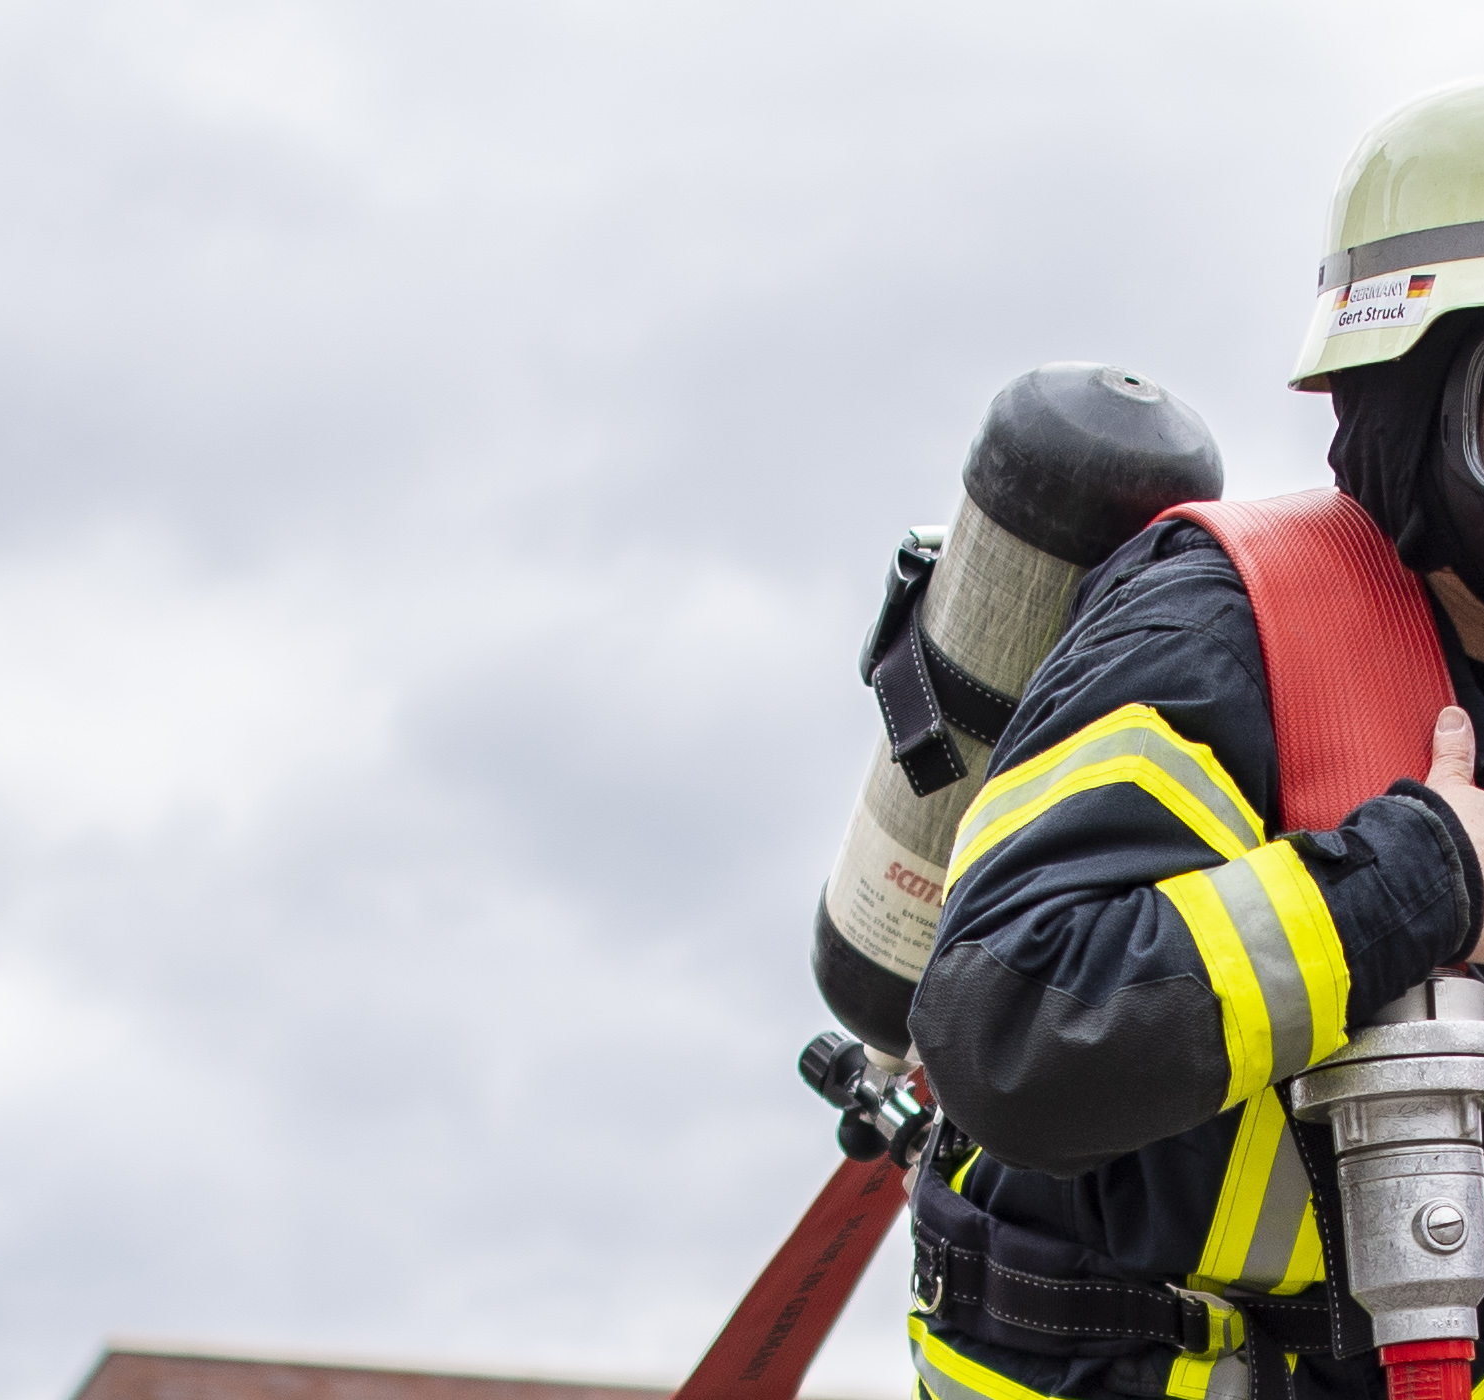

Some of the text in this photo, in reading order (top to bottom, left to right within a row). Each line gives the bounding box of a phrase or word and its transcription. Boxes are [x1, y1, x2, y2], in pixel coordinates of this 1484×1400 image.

[1349, 281, 1406, 303] GERMANY
[1338, 303, 1406, 326] Gert Struck
[737, 1213, 867, 1382] MADE IN GERMANY
